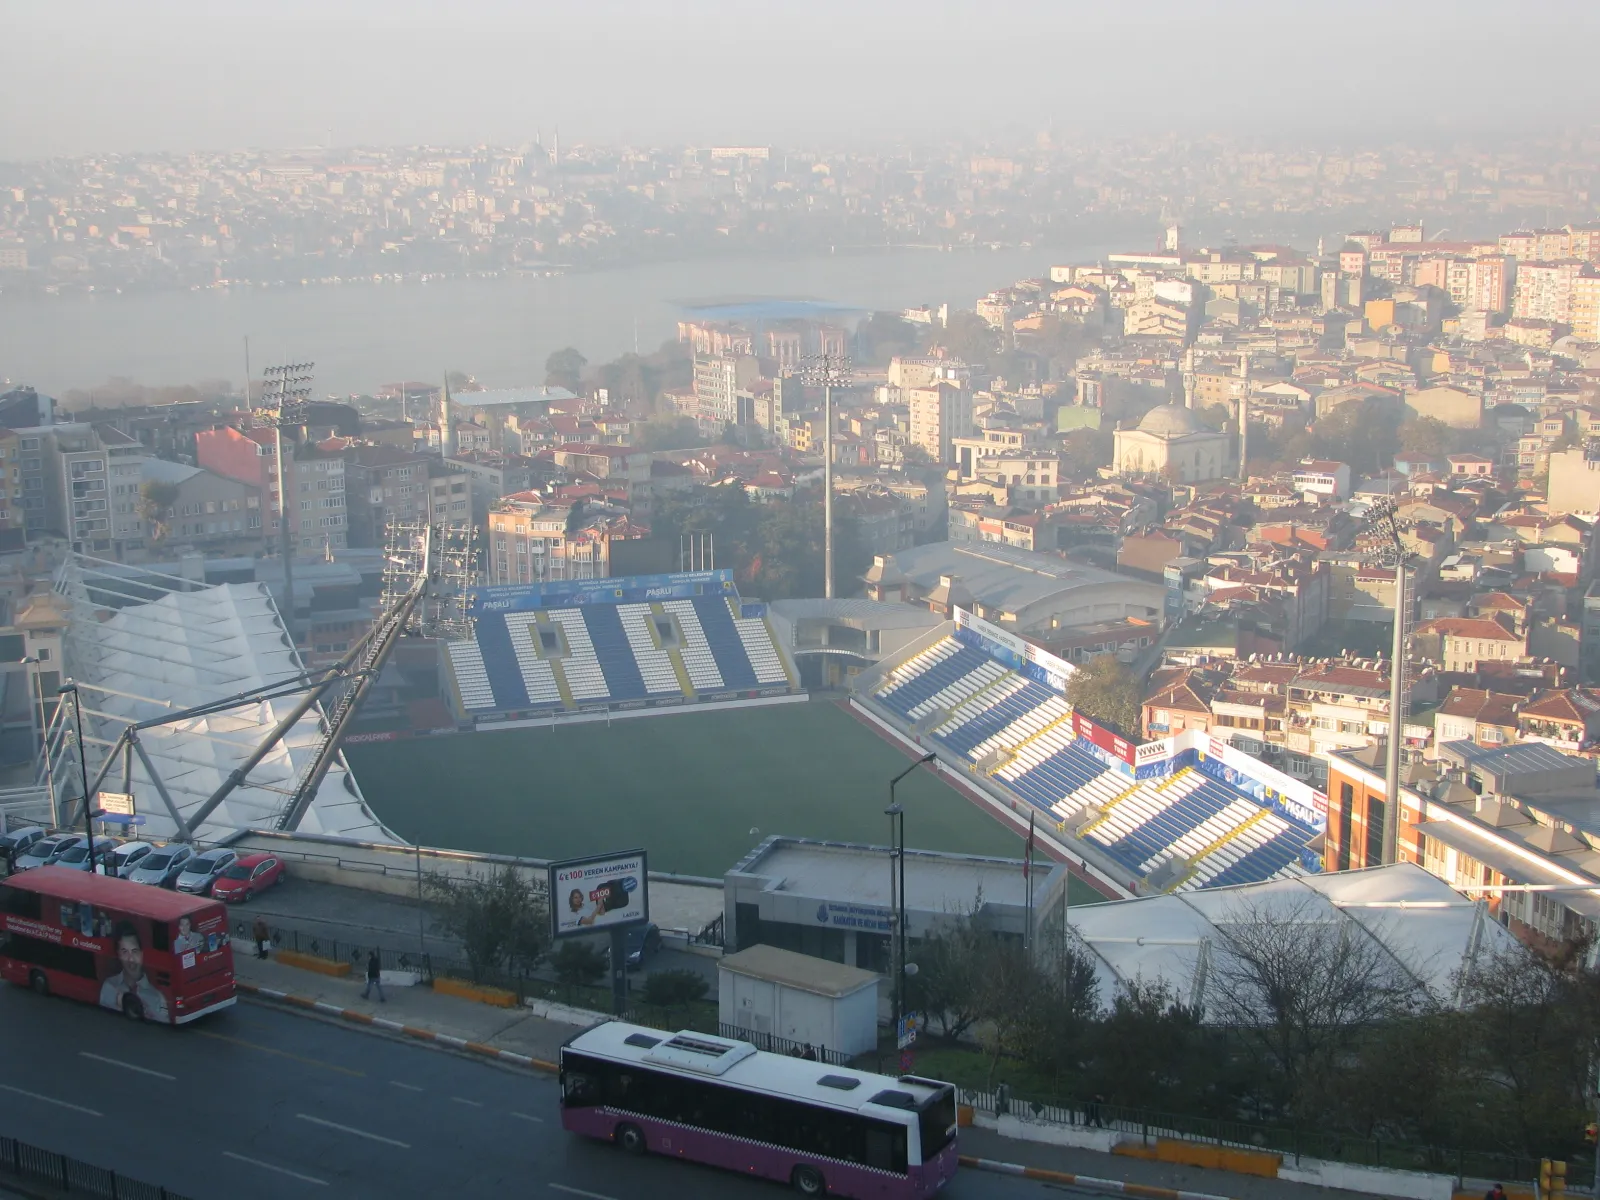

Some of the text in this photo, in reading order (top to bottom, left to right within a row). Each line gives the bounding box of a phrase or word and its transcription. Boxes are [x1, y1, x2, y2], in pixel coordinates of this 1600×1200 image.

[569, 870, 582, 879] 100
[584, 868, 603, 876] VEREN
[604, 862, 639, 873] KAMPANYA!
